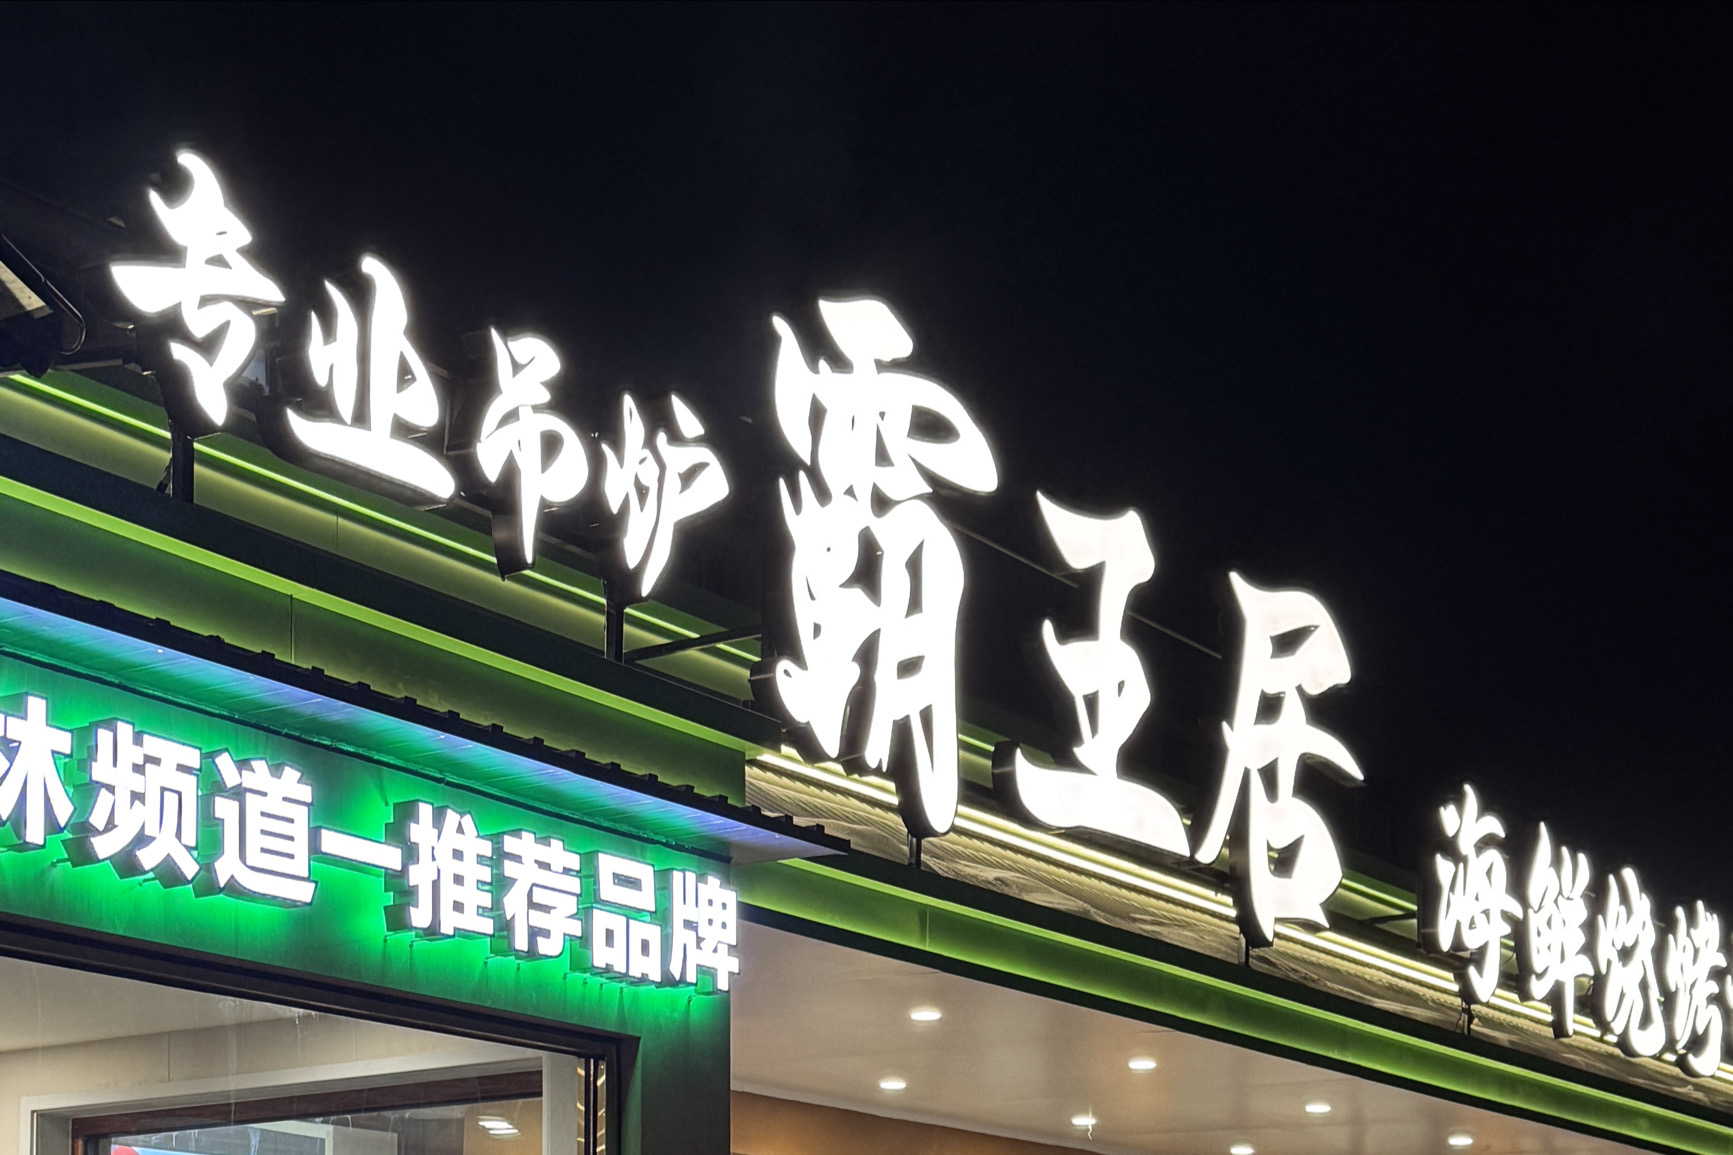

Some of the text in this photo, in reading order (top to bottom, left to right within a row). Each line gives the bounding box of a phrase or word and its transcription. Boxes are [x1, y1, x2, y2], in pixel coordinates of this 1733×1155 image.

[111, 151, 1733, 1078] 专业吊炉 霸王居 海鲜烧烤
